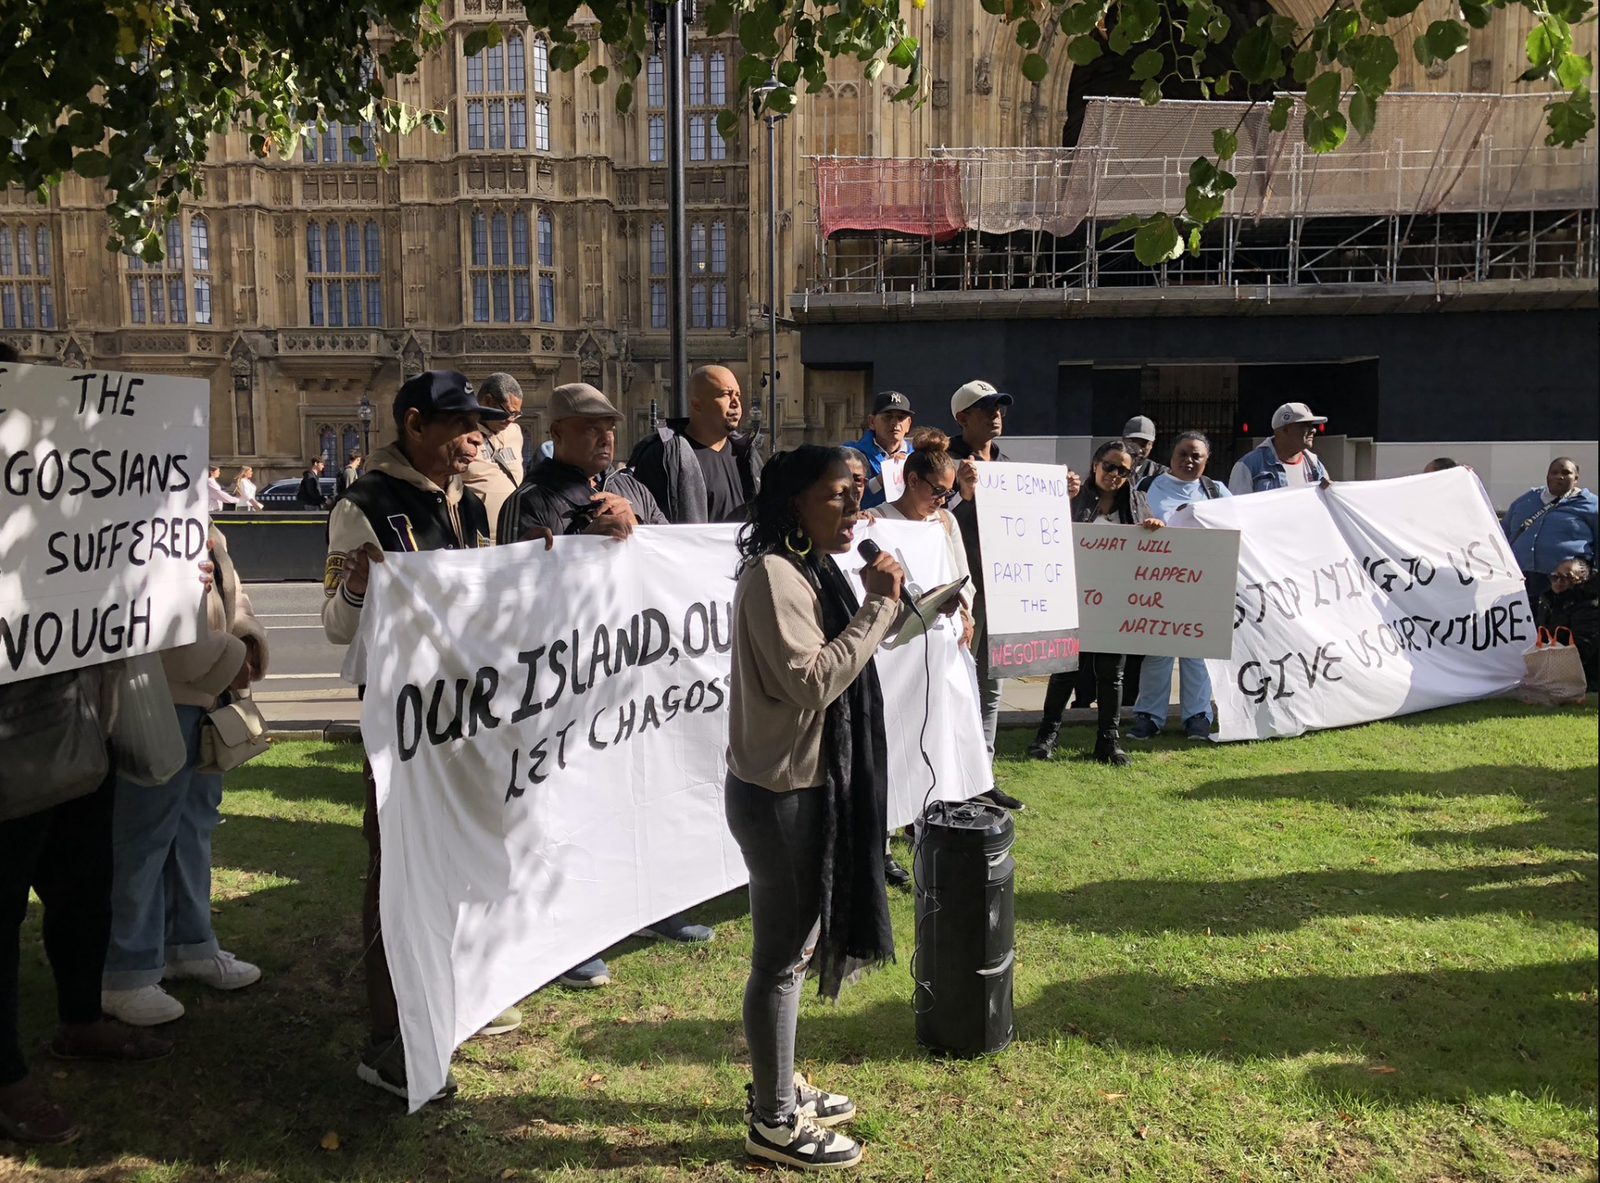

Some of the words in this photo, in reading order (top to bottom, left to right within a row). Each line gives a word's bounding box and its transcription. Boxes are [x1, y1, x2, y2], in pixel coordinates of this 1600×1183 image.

[68, 374, 145, 417] THE
[4, 448, 191, 500] GOSSIANS
[978, 474, 1008, 490] WE
[1016, 474, 1065, 498] DEMAND
[1000, 515, 1026, 537] TO
[1040, 517, 1060, 545] BE
[46, 517, 206, 575] SUFFERED
[1079, 537, 1127, 551] WHAT
[1137, 540, 1172, 554] WILL
[993, 562, 1034, 584] PART
[1044, 563, 1063, 583] OF
[1134, 566, 1203, 584] HAPPEN
[1020, 599, 1048, 613] THE
[1083, 588, 1103, 606] TO
[1127, 591, 1164, 609] OUR
[1118, 618, 1205, 638] NATIVES
[991, 637, 1079, 668] NEGOTIATION
[1237, 641, 1343, 704] GIVE
[1345, 629, 1383, 669] US
[396, 666, 501, 762] OUR
[511, 607, 680, 725] ISLAND,
[505, 719, 577, 803] LET
